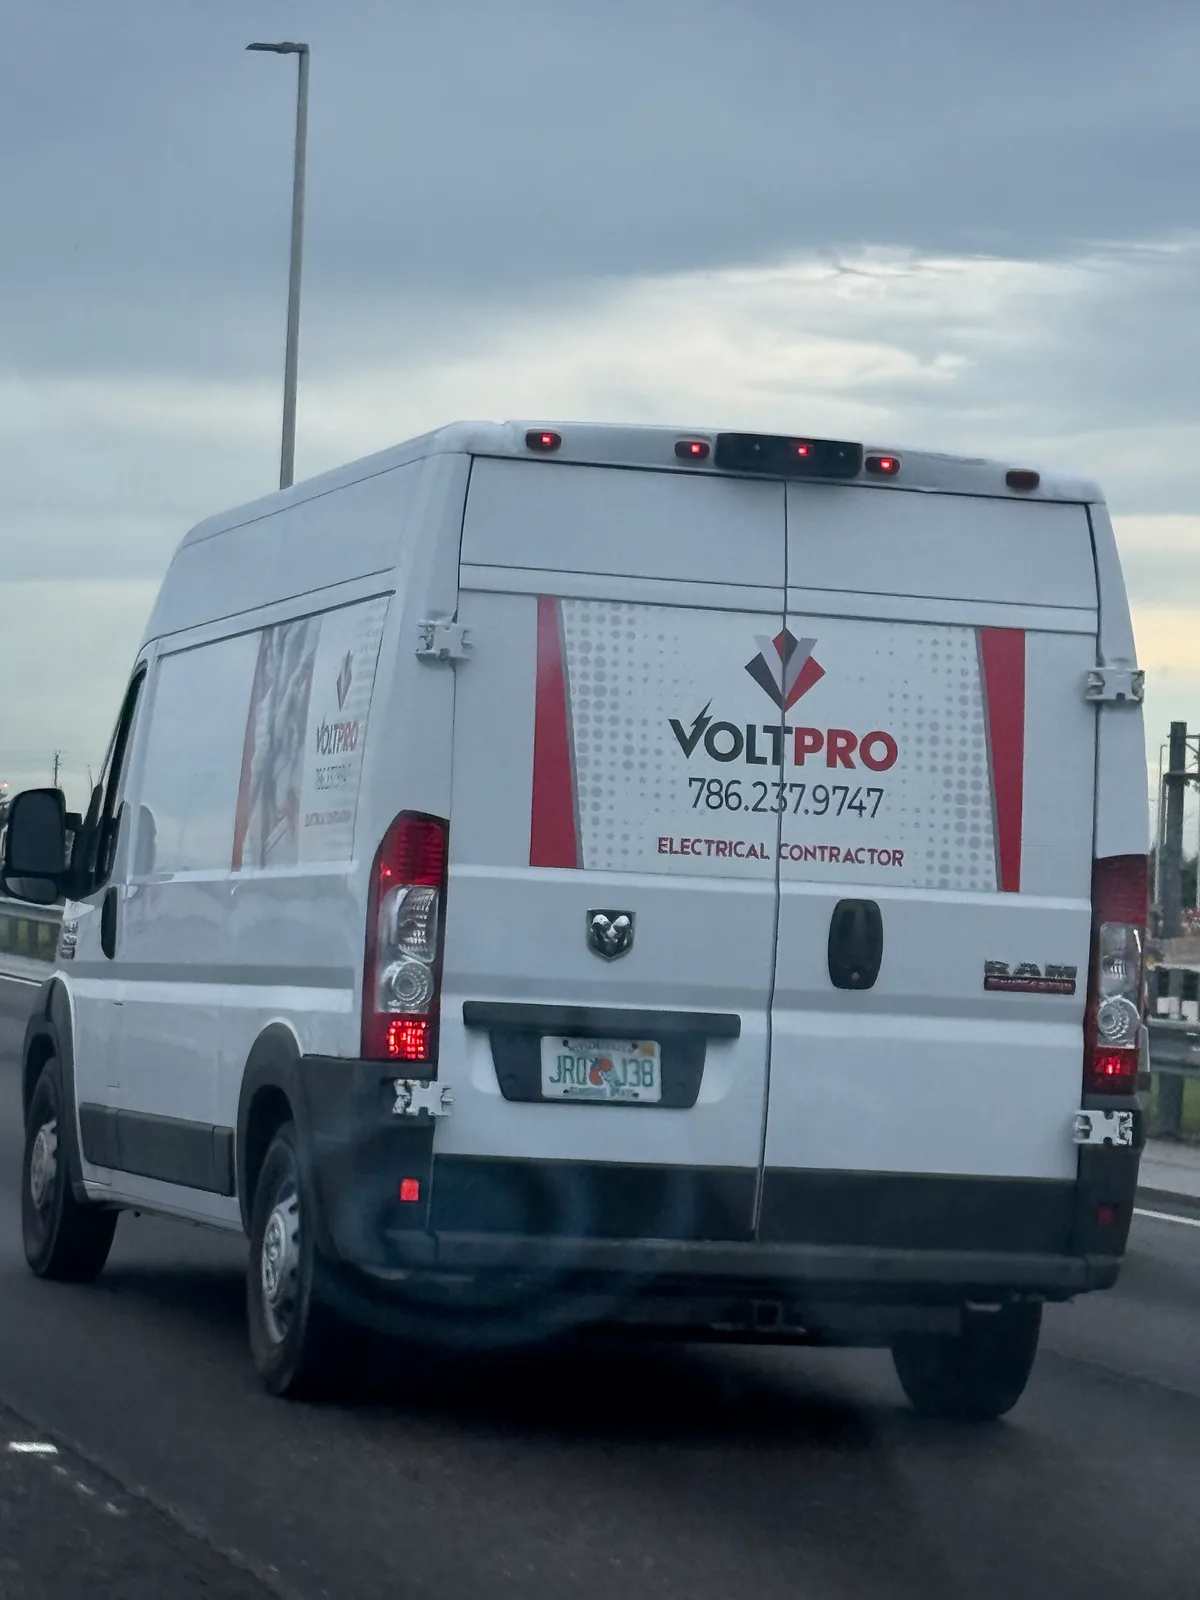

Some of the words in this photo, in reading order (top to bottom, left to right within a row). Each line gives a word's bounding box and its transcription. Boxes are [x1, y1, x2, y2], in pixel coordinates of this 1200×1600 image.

[688, 777, 884, 818] 786.237.9747
[658, 837, 770, 860] ELECTRICAL
[779, 843, 904, 867] CONTRACTOR
